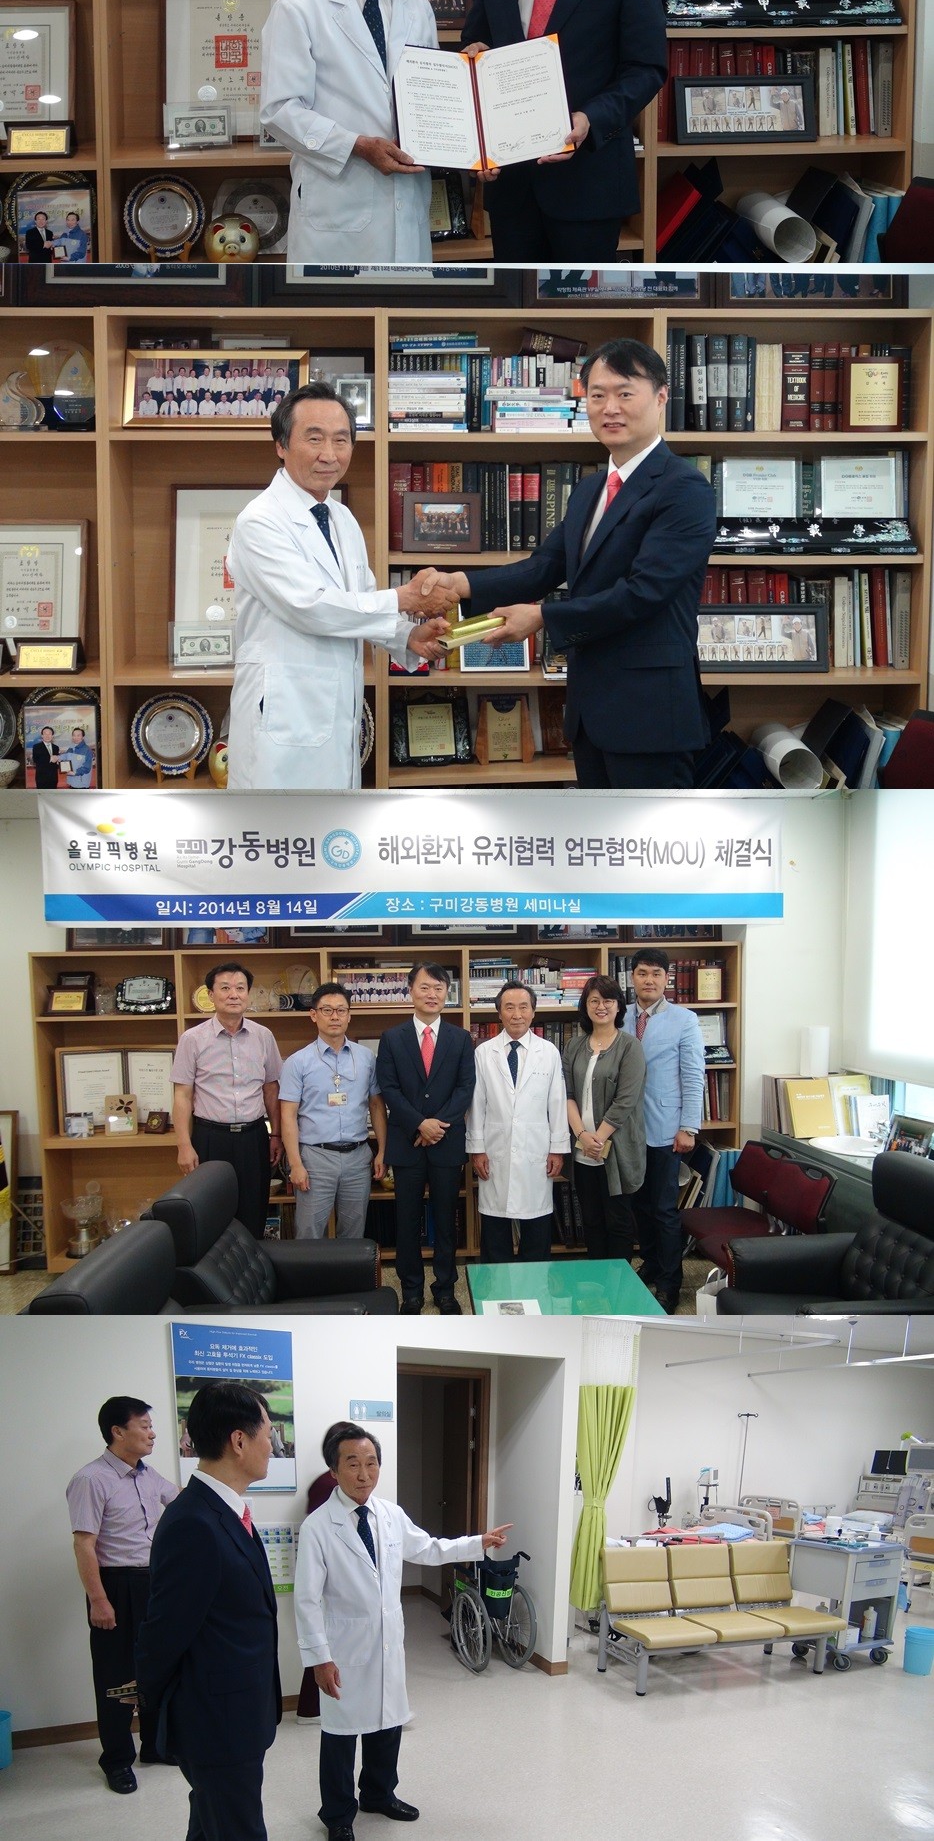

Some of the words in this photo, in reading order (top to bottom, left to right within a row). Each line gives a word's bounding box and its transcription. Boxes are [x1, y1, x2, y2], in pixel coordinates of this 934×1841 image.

[546, 494, 556, 528] SPINE
[67, 839, 158, 861] 올림픽병원
[211, 831, 316, 869] 강동병원
[331, 845, 350, 859] GD
[377, 835, 464, 865] 해외환자
[472, 836, 555, 866] 유치협력
[565, 837, 706, 868] 업무협약(MOU)
[714, 837, 772, 867] 체결식
[69, 862, 110, 872] OLYMPIC
[114, 863, 160, 872] HOSPITAL
[156, 901, 193, 915] 일시:
[199, 901, 251, 915] 2014년
[256, 900, 281, 914] 8월
[287, 900, 318, 915] 14일
[385, 897, 415, 912] 장소
[429, 897, 519, 913] 구미강동병원
[524, 898, 581, 913] 세미나실
